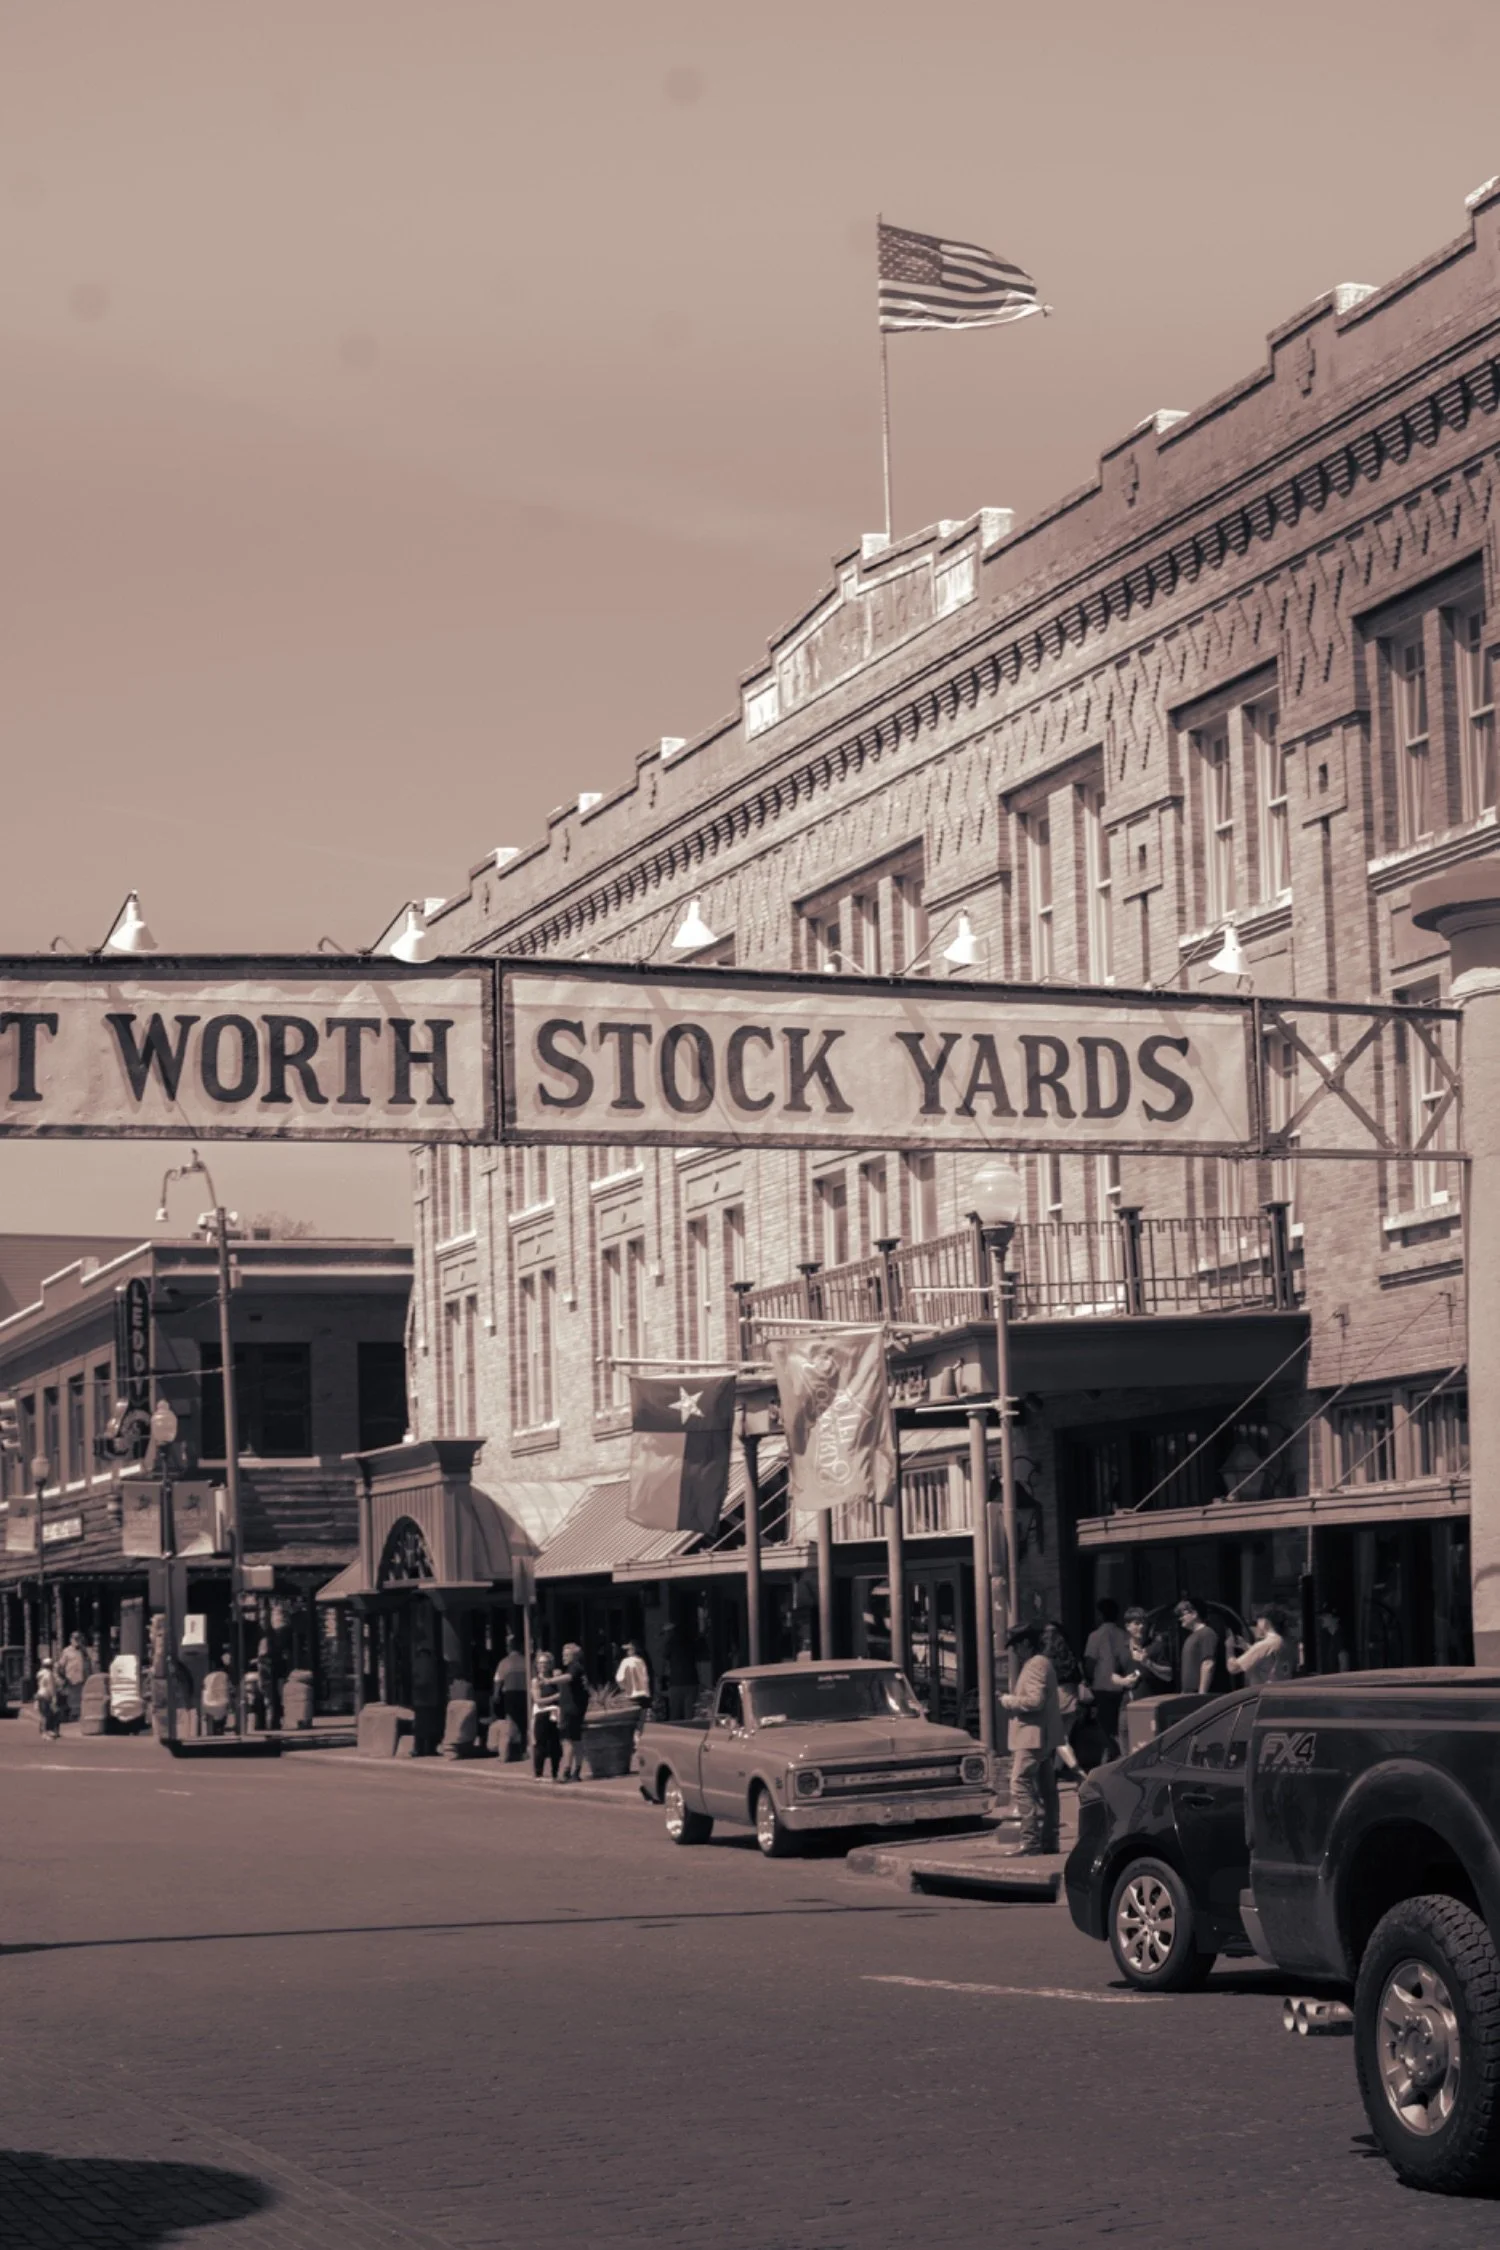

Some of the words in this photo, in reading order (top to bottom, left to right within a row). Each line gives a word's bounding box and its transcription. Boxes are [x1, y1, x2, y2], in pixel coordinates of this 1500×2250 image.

[104, 1013, 455, 1107] WORTH
[536, 1018, 854, 1114] STOCK
[895, 1030, 1195, 1123] YARDS
[1258, 1732, 1317, 1766] FX4
